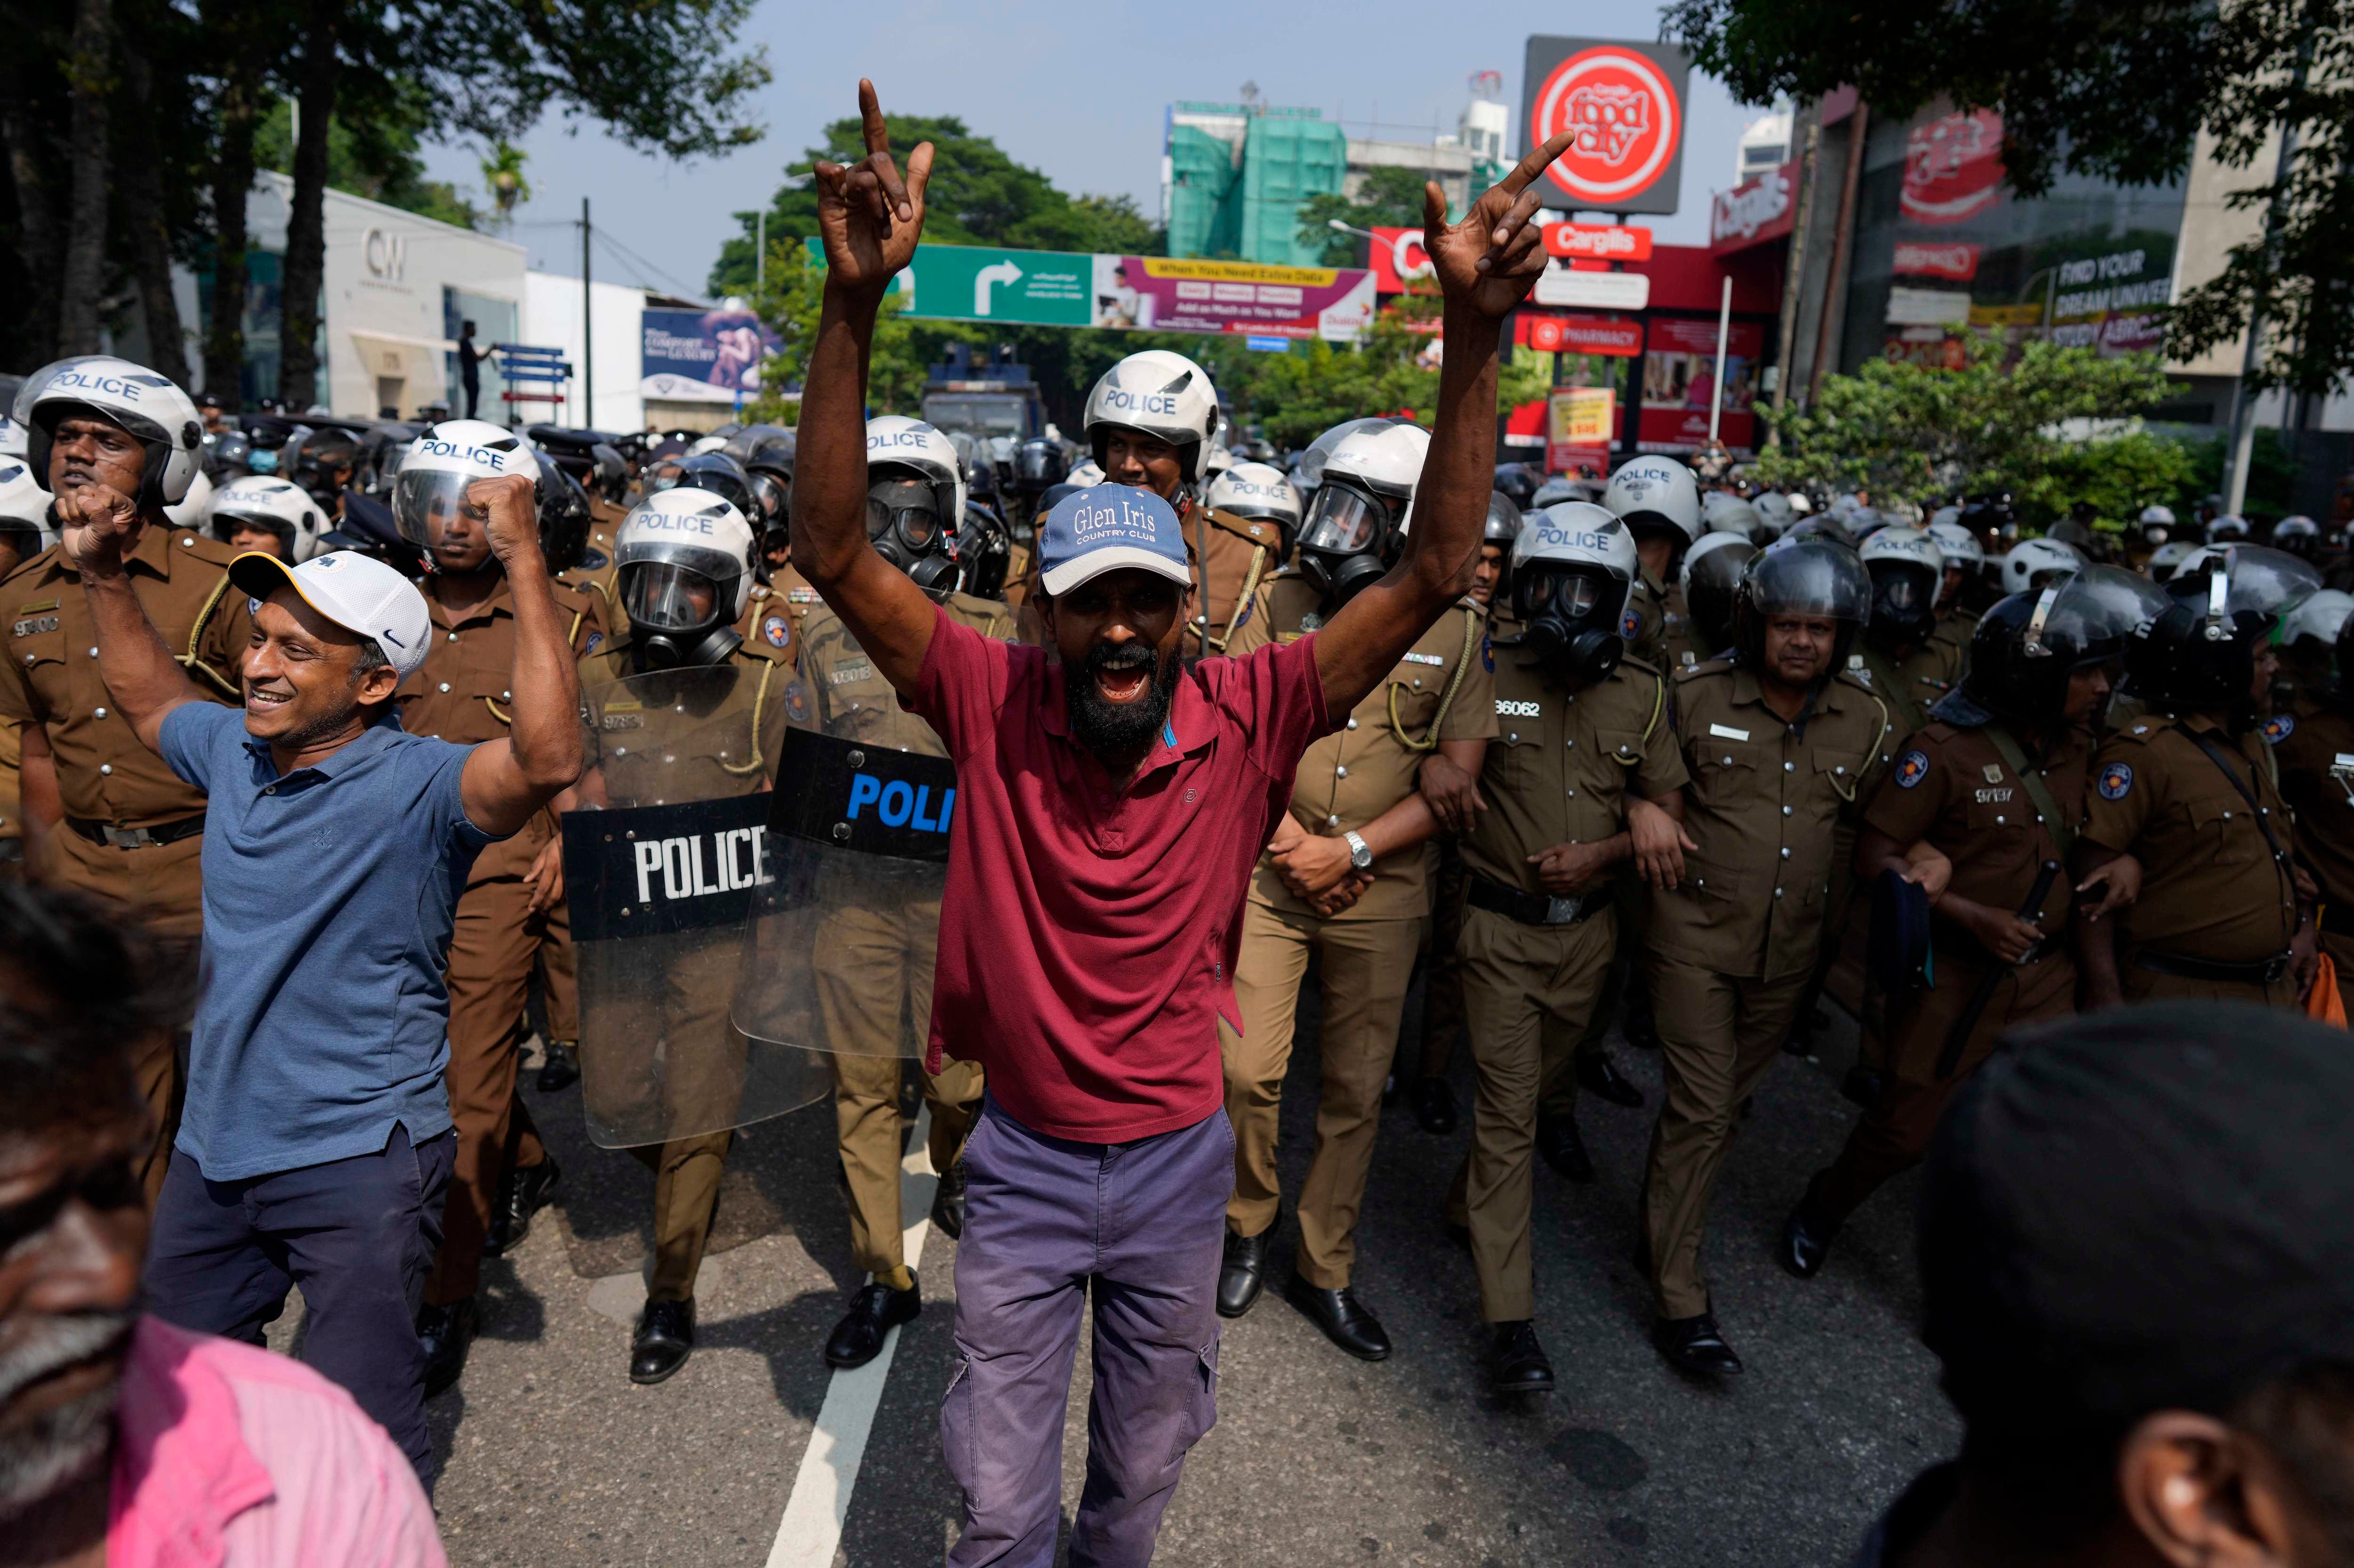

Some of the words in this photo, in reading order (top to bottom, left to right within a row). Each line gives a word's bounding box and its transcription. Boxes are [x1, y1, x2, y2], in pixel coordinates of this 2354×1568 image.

[1557, 225, 1636, 255] Cargills
[1198, 265, 1221, 276] You
[1225, 267, 1257, 277] Need
[2098, 249, 2145, 279] YOUR
[1562, 328, 1637, 346] PHARMACY
[49, 374, 140, 401] POLICE
[1105, 390, 1175, 415] POLICE
[867, 433, 928, 450] OLICE
[419, 441, 504, 471] POLICE
[1616, 469, 1670, 486] POLICE
[1233, 483, 1288, 500] POLICE
[636, 514, 713, 535] POLICE
[1074, 506, 1117, 534] Glen
[1122, 501, 1155, 532] Iris
[1077, 530, 1126, 545] COUNTRY
[1129, 530, 1156, 542] CLUB
[1535, 529, 1609, 552] POLICE
[846, 773, 956, 833] POLI
[633, 825, 775, 903] POLICE
